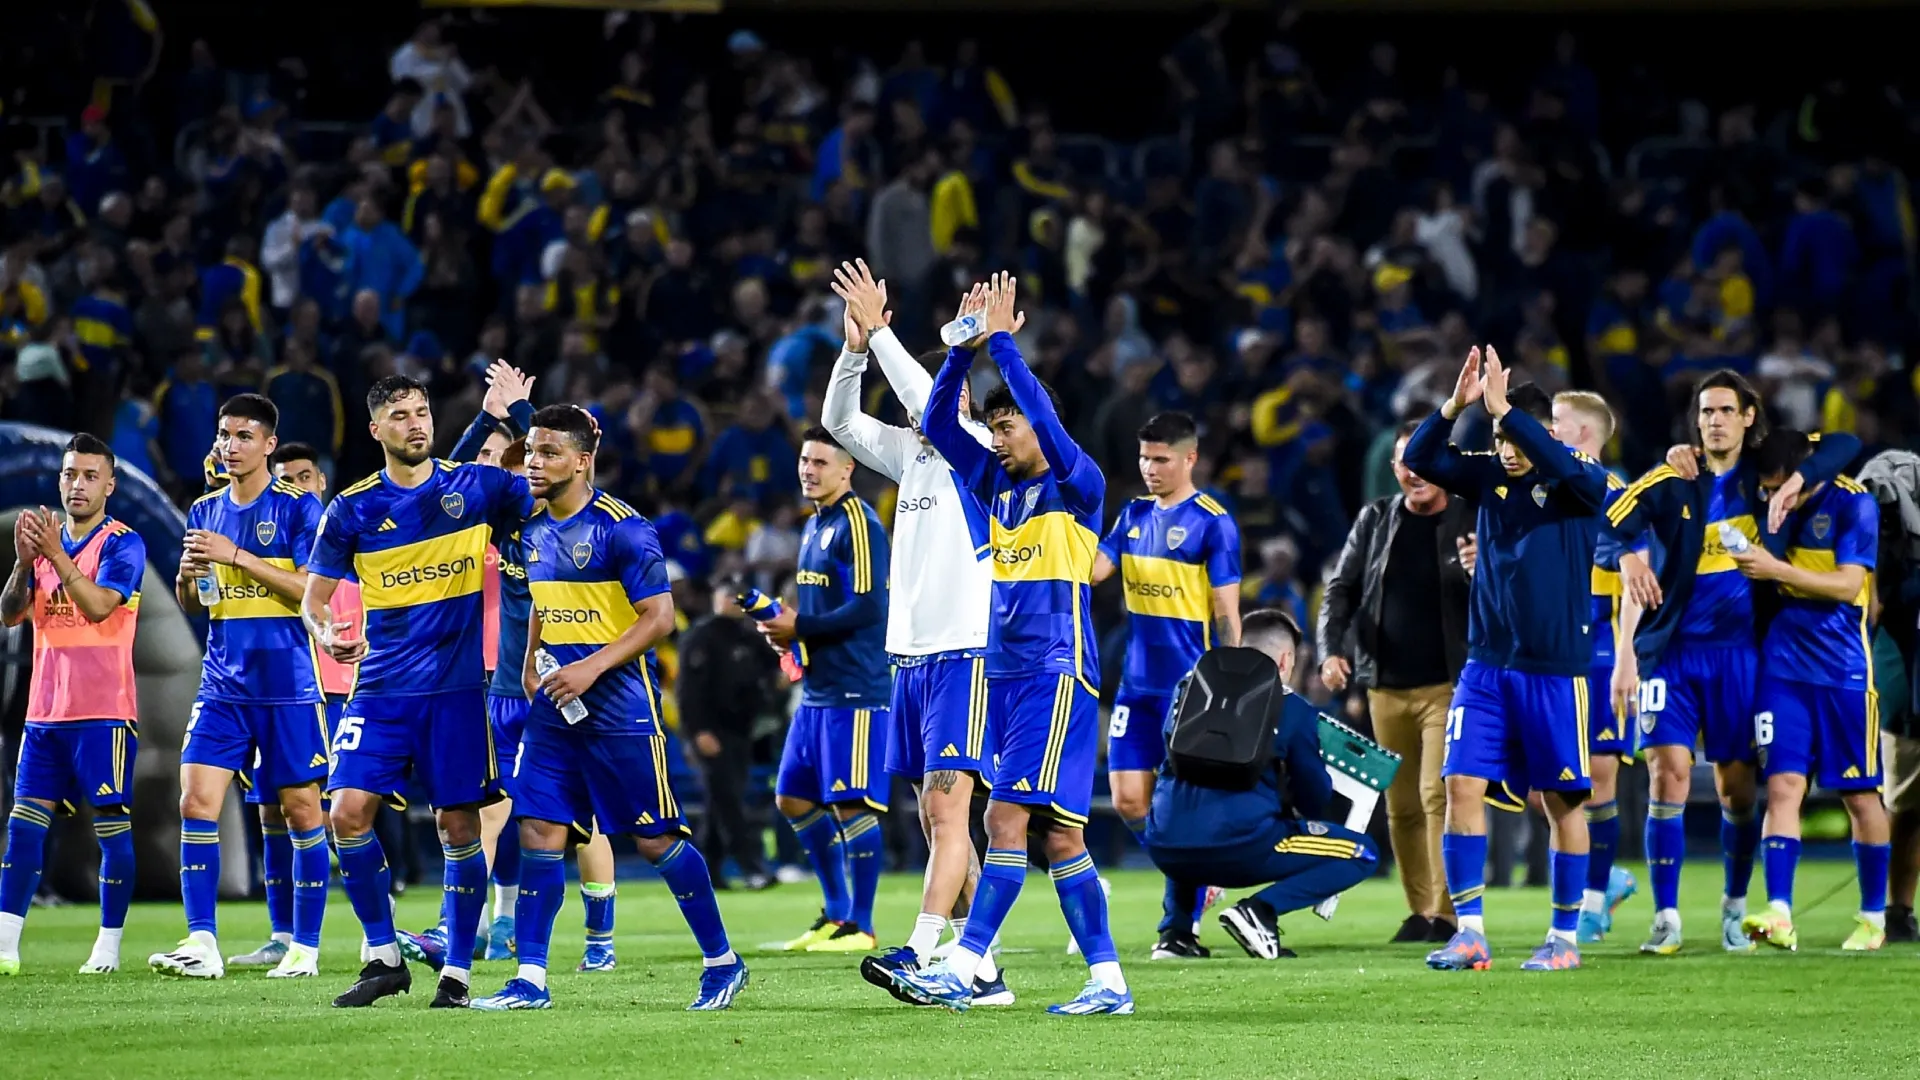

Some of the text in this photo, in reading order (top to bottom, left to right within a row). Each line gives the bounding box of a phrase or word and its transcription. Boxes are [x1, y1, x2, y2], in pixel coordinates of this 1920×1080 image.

[381, 555, 475, 588] betsson
[1641, 678, 1667, 713] 10
[331, 716, 366, 754] 25
